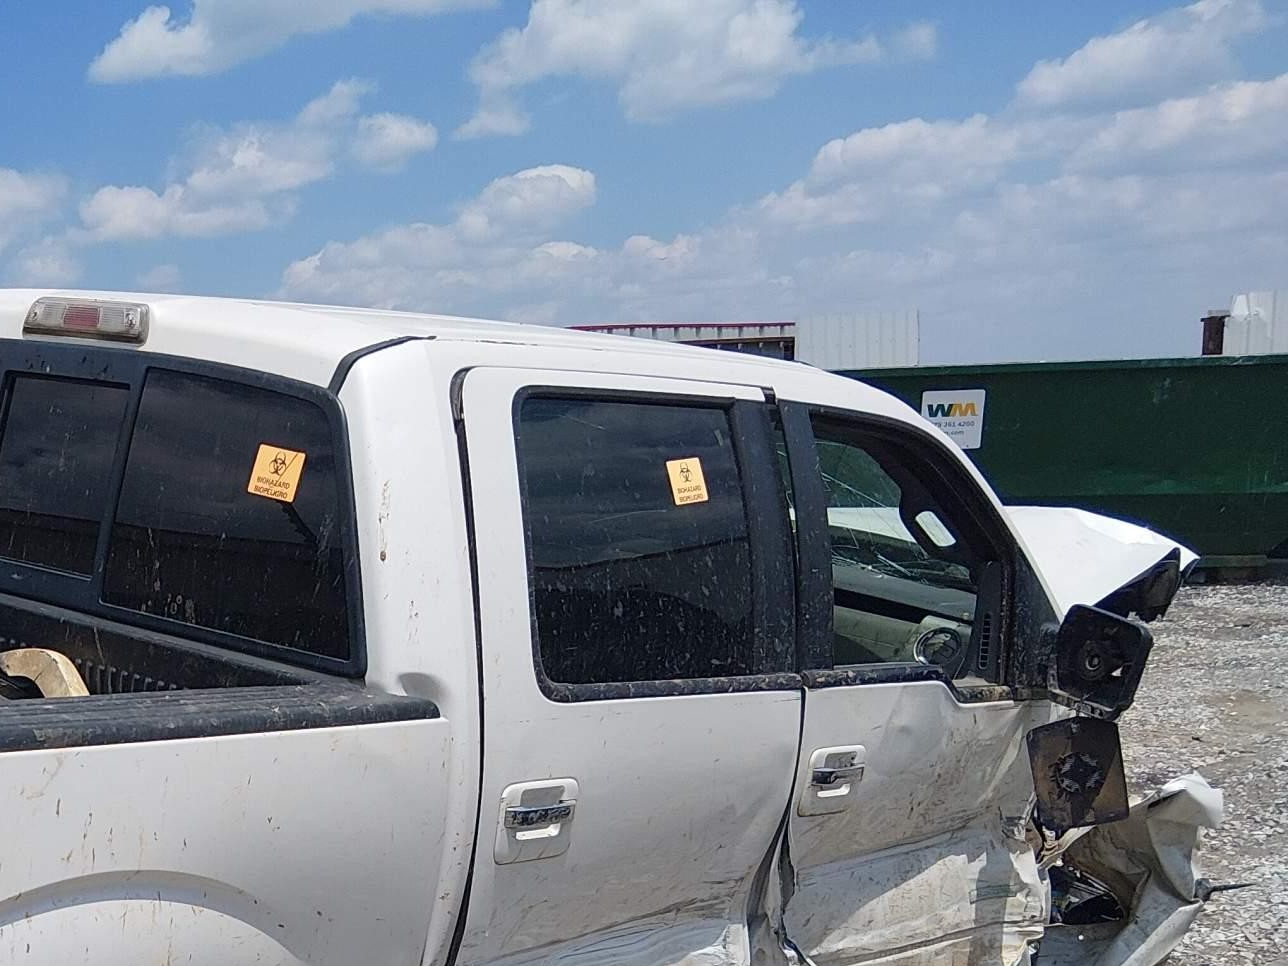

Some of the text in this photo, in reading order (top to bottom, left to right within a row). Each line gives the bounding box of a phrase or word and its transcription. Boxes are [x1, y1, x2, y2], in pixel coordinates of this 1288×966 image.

[927, 403, 978, 418] WM
[256, 476, 291, 490] BIOHAZARD
[254, 485, 288, 499] BIOPELIGRO
